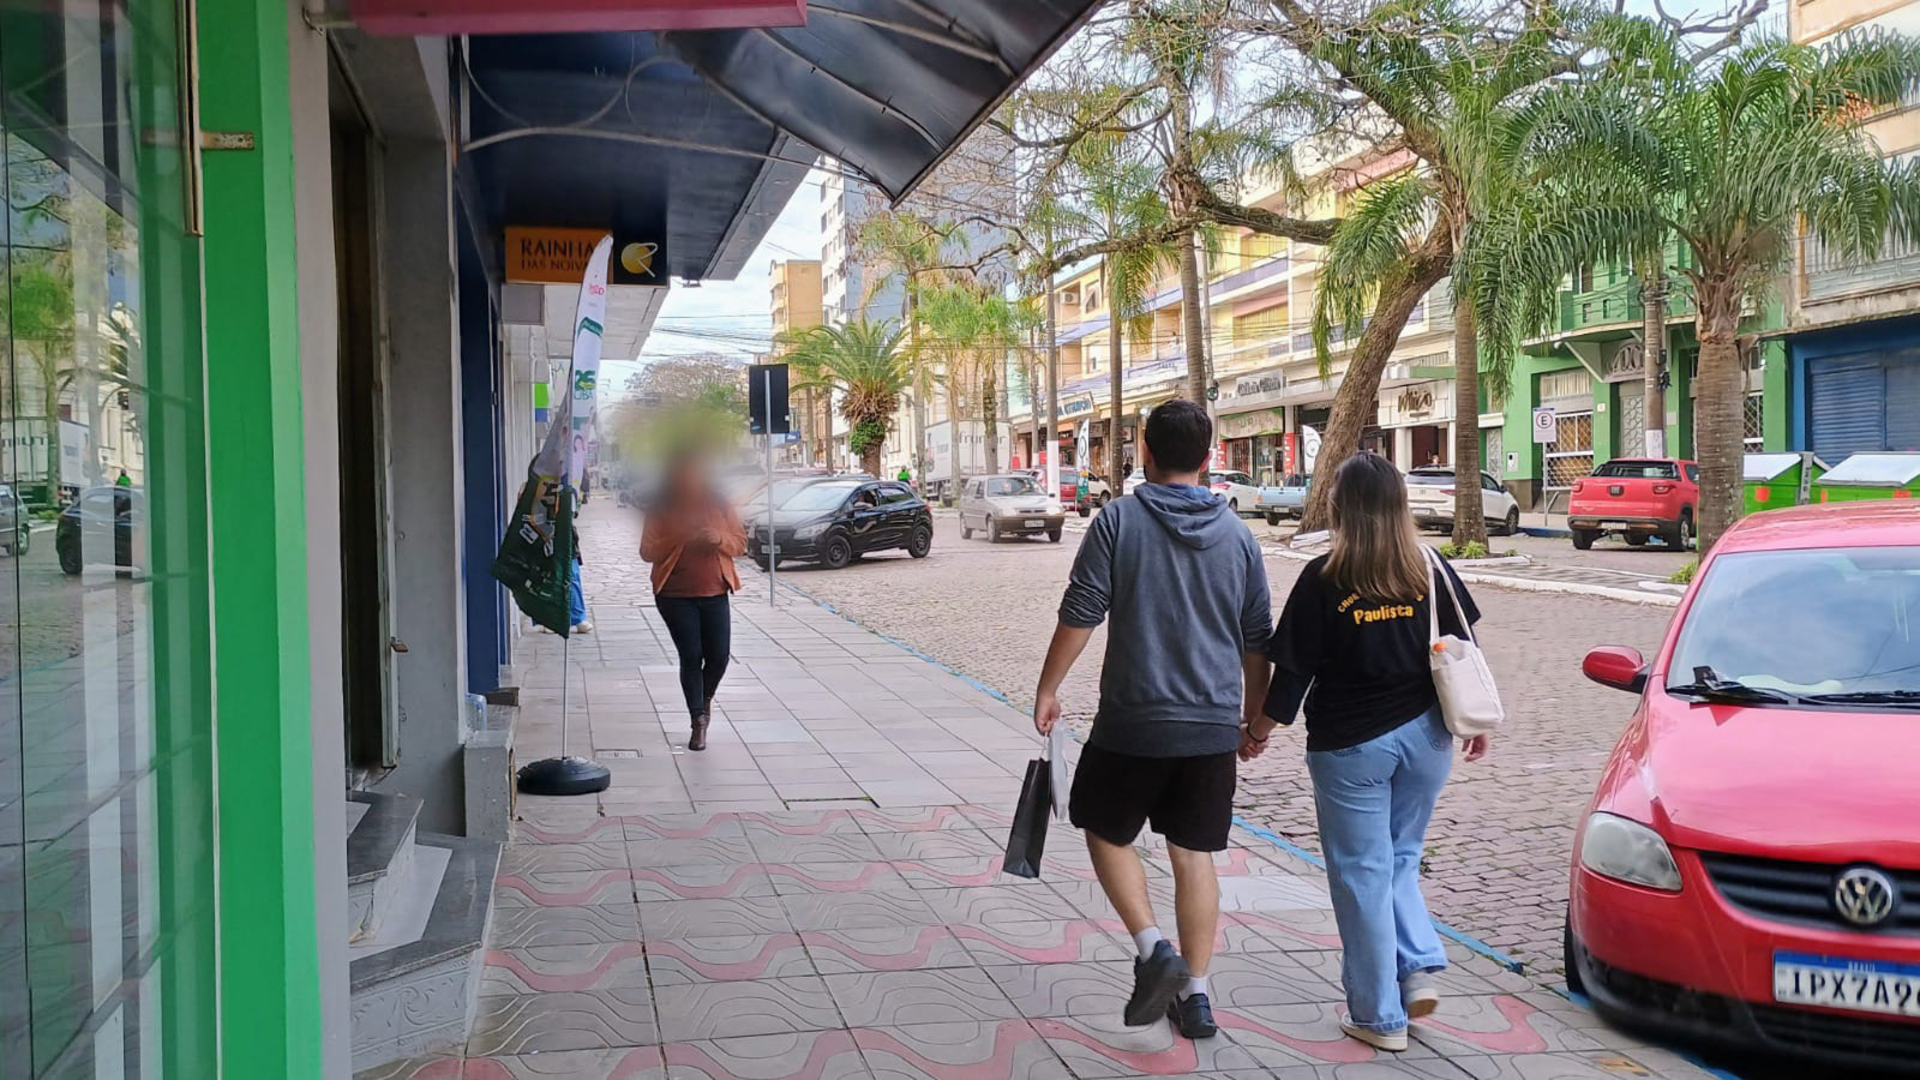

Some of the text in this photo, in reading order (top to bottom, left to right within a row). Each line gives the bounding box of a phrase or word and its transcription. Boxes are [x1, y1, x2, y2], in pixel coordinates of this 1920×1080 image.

[521, 238, 594, 258] RAINHA
[521, 258, 588, 271] DAS NOIVA
[1541, 415, 1548, 426] E
[1353, 604, 1414, 625] Paulista
[1792, 970, 1920, 1009] IPX7A9
